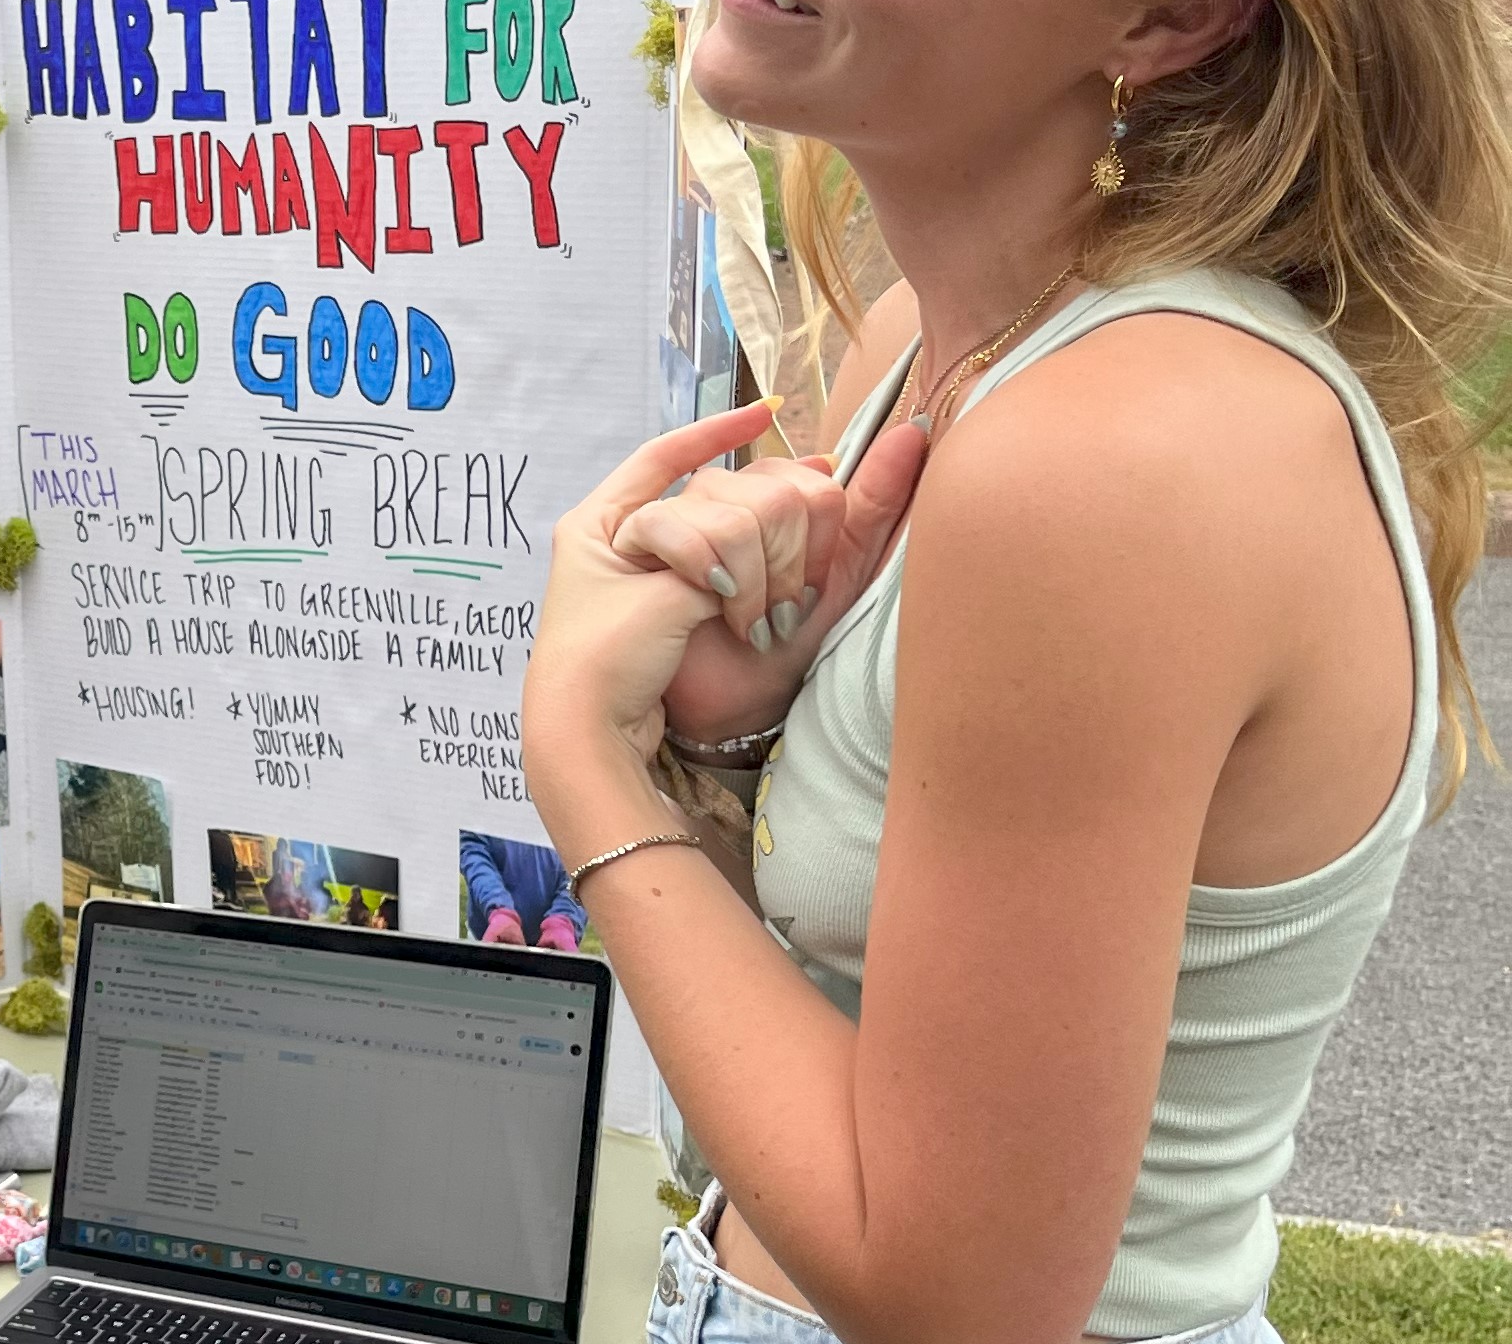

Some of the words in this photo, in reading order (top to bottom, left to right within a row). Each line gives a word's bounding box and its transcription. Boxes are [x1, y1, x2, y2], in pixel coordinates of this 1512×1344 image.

[113, 120, 566, 273] HUMANITY
[123, 292, 199, 384] DO
[232, 281, 455, 412] GOOD
[31, 432, 99, 464] THIS
[32, 467, 120, 510] MARCH
[162, 447, 333, 548] SPRING
[373, 452, 533, 554] BREAK
[71, 562, 167, 610] SERVICE
[183, 571, 236, 609] TRIP
[260, 579, 286, 612] TO
[83, 615, 132, 658] BUILD
[146, 617, 163, 656] A
[171, 616, 234, 655] HOUSE
[248, 619, 363, 662] ALONGSIDE
[386, 630, 403, 668] A
[416, 636, 505, 677] FAMILY
[246, 691, 321, 728] YUMMY
[427, 705, 460, 738] NO
[470, 711, 521, 742] CONS
[252, 728, 345, 760] SOUTHERN
[254, 758, 312, 790] FOOD!
